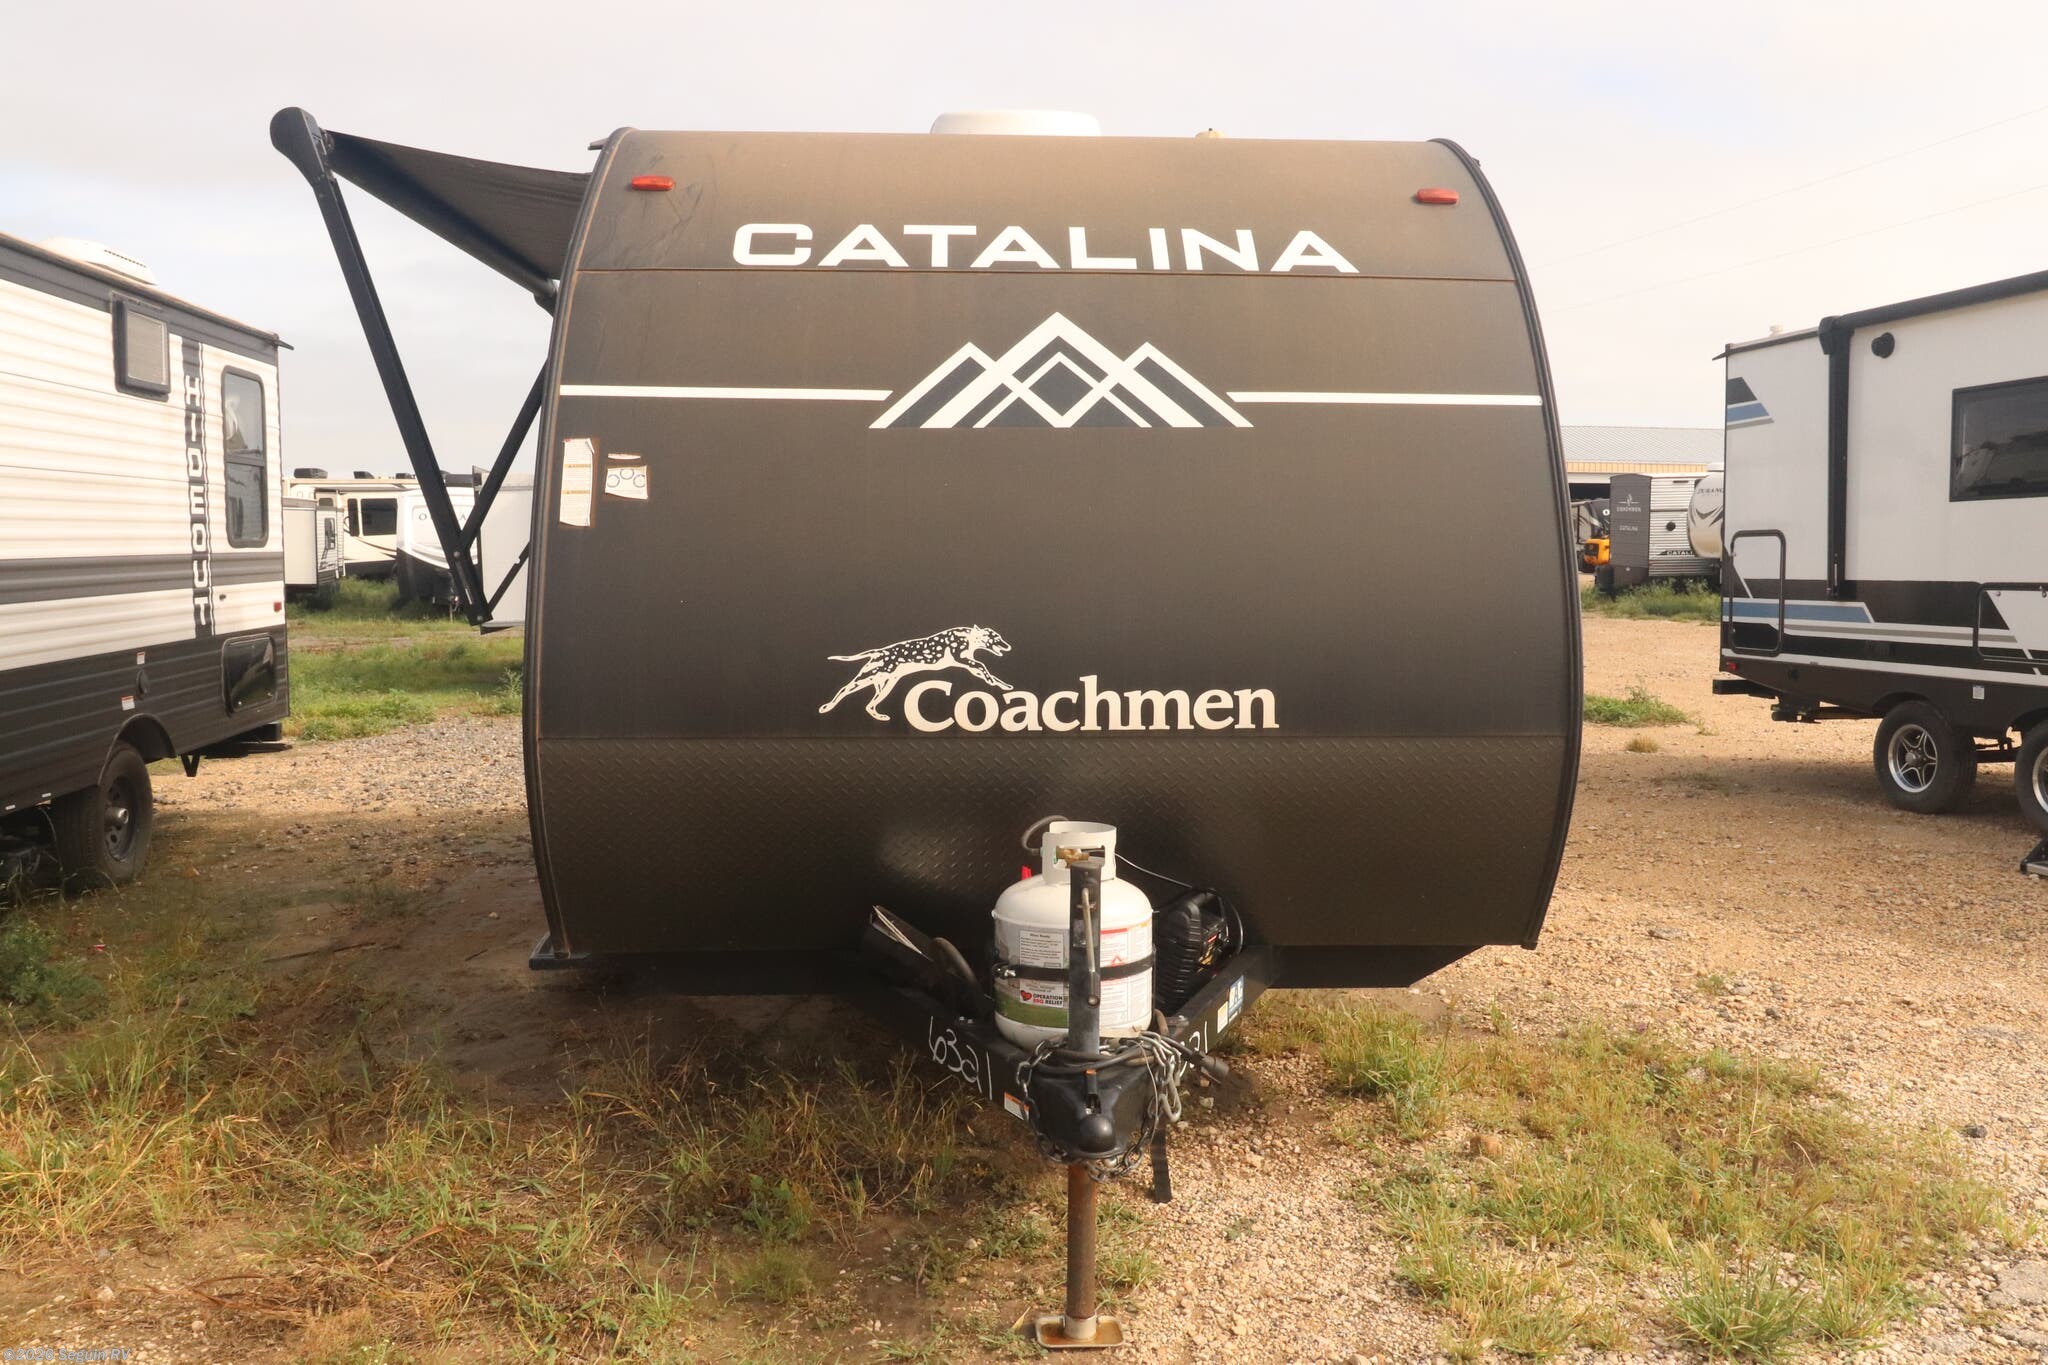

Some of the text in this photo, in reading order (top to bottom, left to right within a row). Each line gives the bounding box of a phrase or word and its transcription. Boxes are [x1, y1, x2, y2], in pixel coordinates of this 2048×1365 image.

[732, 223, 1360, 273] CATALINA
[184, 375, 208, 626] HIDEOUT
[904, 675, 1280, 732] Coachmen
